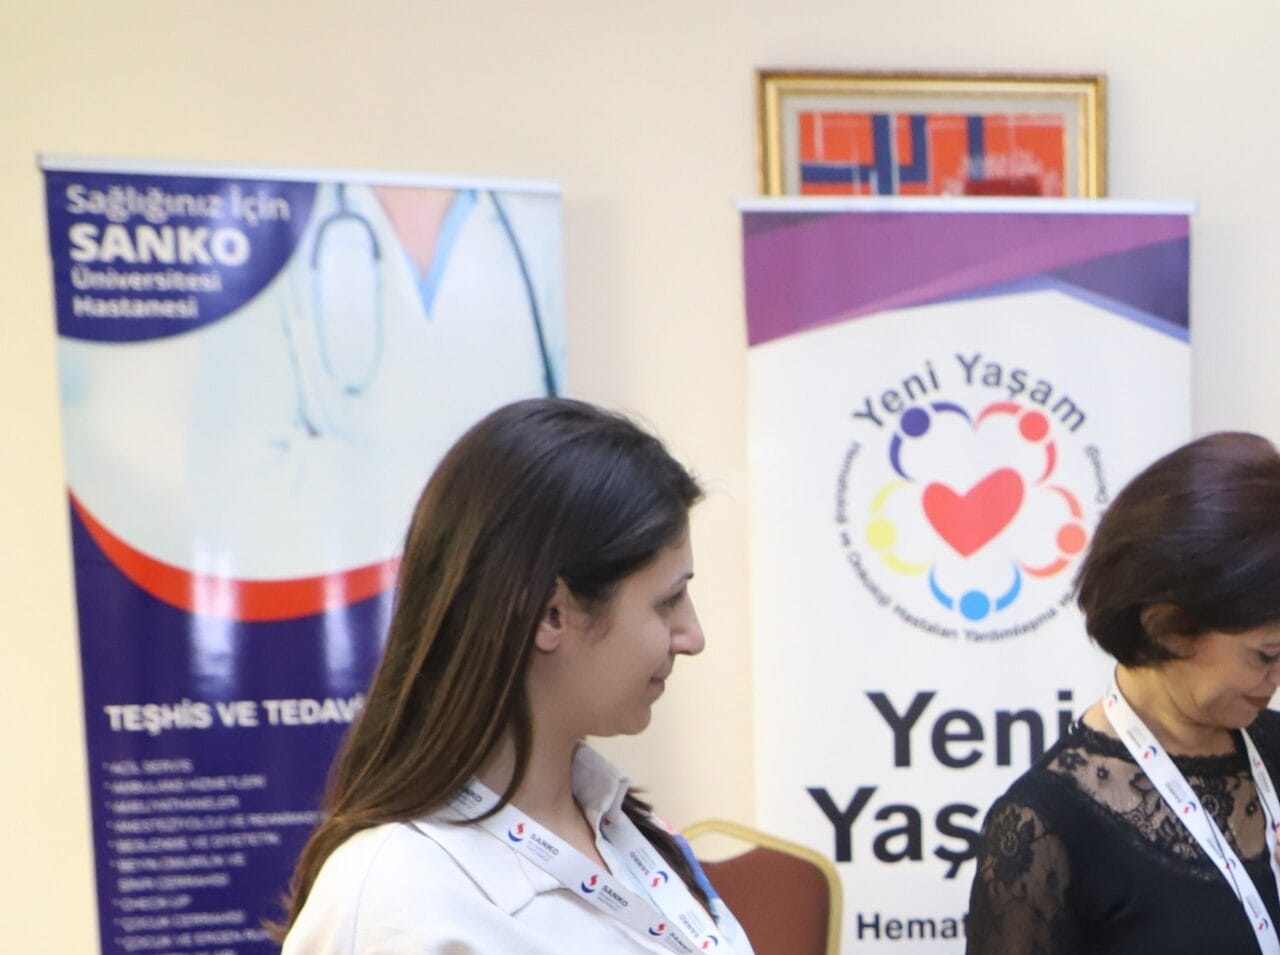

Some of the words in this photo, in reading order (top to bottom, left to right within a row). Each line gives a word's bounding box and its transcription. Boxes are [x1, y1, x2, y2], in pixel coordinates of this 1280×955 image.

[65, 183, 222, 224] Sağlığınız
[69, 222, 251, 266] SANKO
[70, 263, 222, 292] Üniversitesi
[73, 295, 199, 319] Hastanesi
[853, 360, 940, 430] Yeni
[955, 352, 1088, 433] Yaşam
[104, 698, 213, 736] TEŞHİS
[216, 700, 259, 728] VE
[865, 689, 1074, 769] Yeni
[529, 833, 560, 856] SANKO
[602, 885, 629, 907] SANKO
[857, 912, 968, 940] Hema
